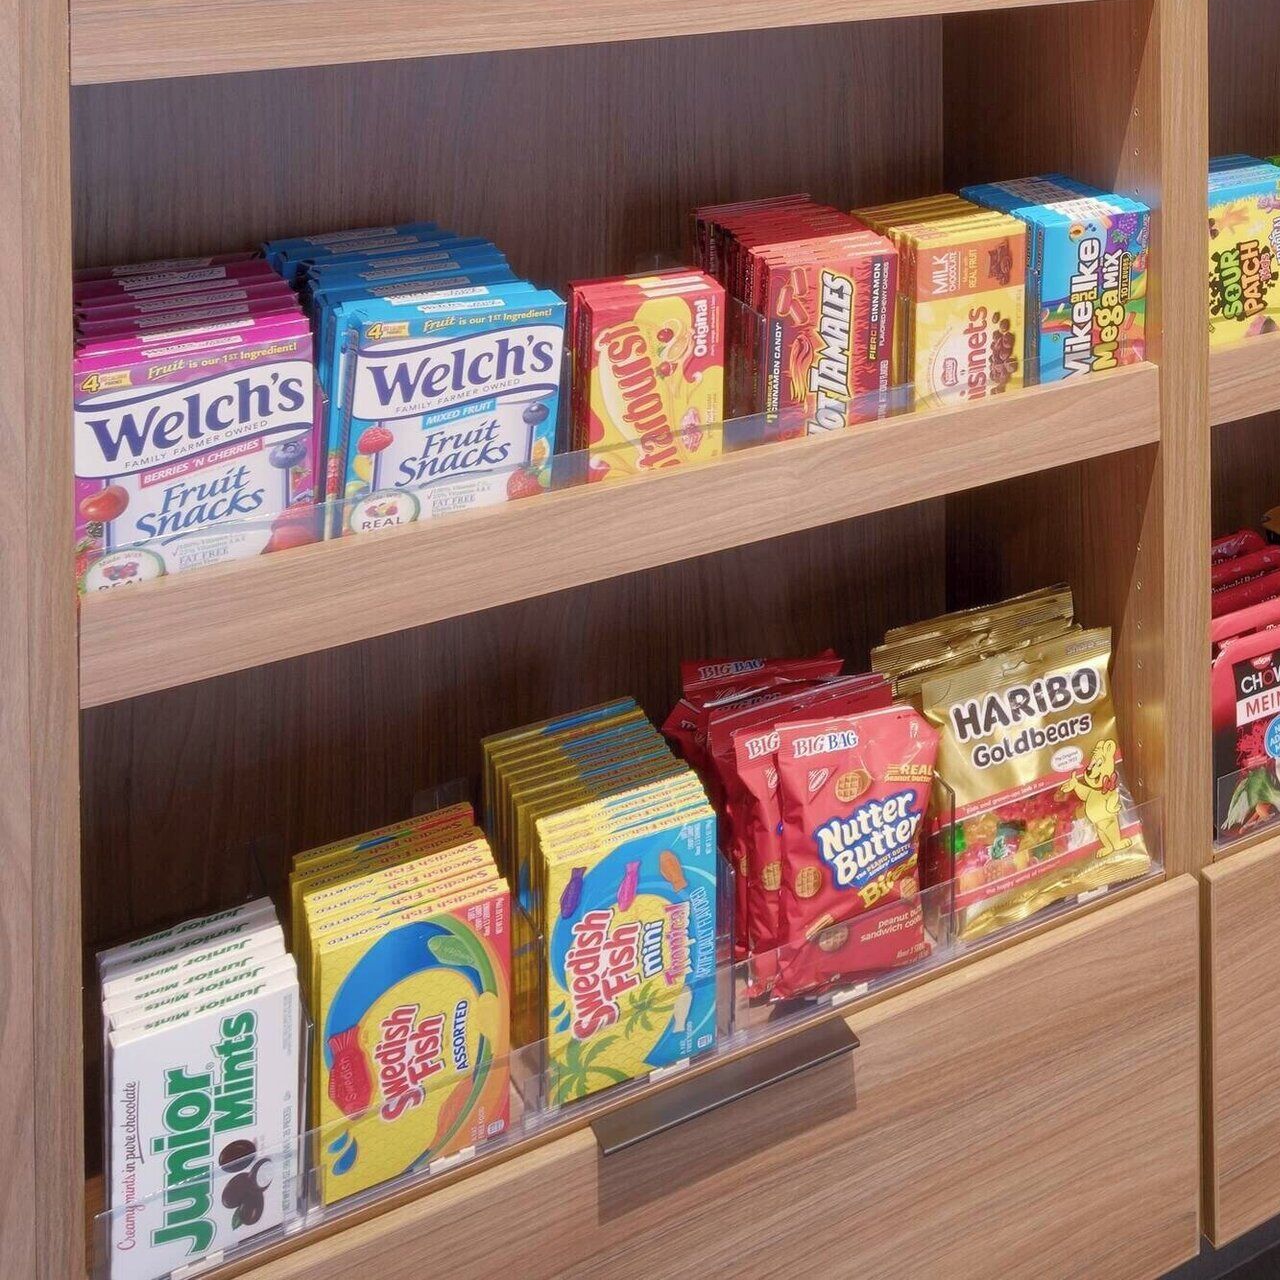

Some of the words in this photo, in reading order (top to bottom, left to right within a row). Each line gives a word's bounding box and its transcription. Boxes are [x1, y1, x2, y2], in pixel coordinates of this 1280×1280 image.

[932, 250, 949, 294] MILK
[1219, 249, 1244, 320] SOUR
[1238, 239, 1267, 317] PATCH
[694, 298, 708, 357] Original
[774, 322, 783, 360] CANDY
[809, 270, 854, 398] TAMALES
[148, 358, 185, 379] Fruit
[188, 359, 199, 369] is
[201, 357, 220, 367] our
[223, 353, 238, 363] 1ST
[241, 342, 297, 360] Ingredient!
[366, 335, 554, 407] Welch's
[772, 360, 782, 413] CINNAMON
[85, 372, 305, 462] Welch's
[395, 401, 432, 414] FAMILY
[437, 388, 479, 405] FARMER
[482, 378, 520, 393] OWNED
[425, 409, 460, 426] MIXED
[463, 401, 493, 416] FRUIT
[125, 451, 167, 469] FAMILY
[173, 435, 220, 455] FARMER
[224, 419, 268, 438] OWNED
[143, 462, 189, 484] BERRIES
[192, 455, 205, 468] 'N
[208, 440, 259, 464] CHERRIES
[395, 442, 512, 487] Snacks
[421, 419, 502, 460] Fruit
[131, 488, 265, 547] Snacks
[161, 465, 252, 514] Fruit
[361, 517, 403, 530] REAL
[953, 667, 1098, 740] HARIBO
[745, 732, 780, 759] BIG
[973, 714, 1092, 768] Goldbears
[817, 792, 914, 854] Nutter
[832, 813, 921, 886] Butter
[565, 908, 617, 1041] Swedish
[602, 921, 643, 1001] Fish
[642, 919, 664, 979] mini
[375, 1002, 424, 1122] Swedish
[408, 1012, 449, 1087] Fish
[450, 999, 469, 1071] ASSORTED
[210, 1008, 259, 1134] Mints
[150, 1064, 215, 1258] Junior
